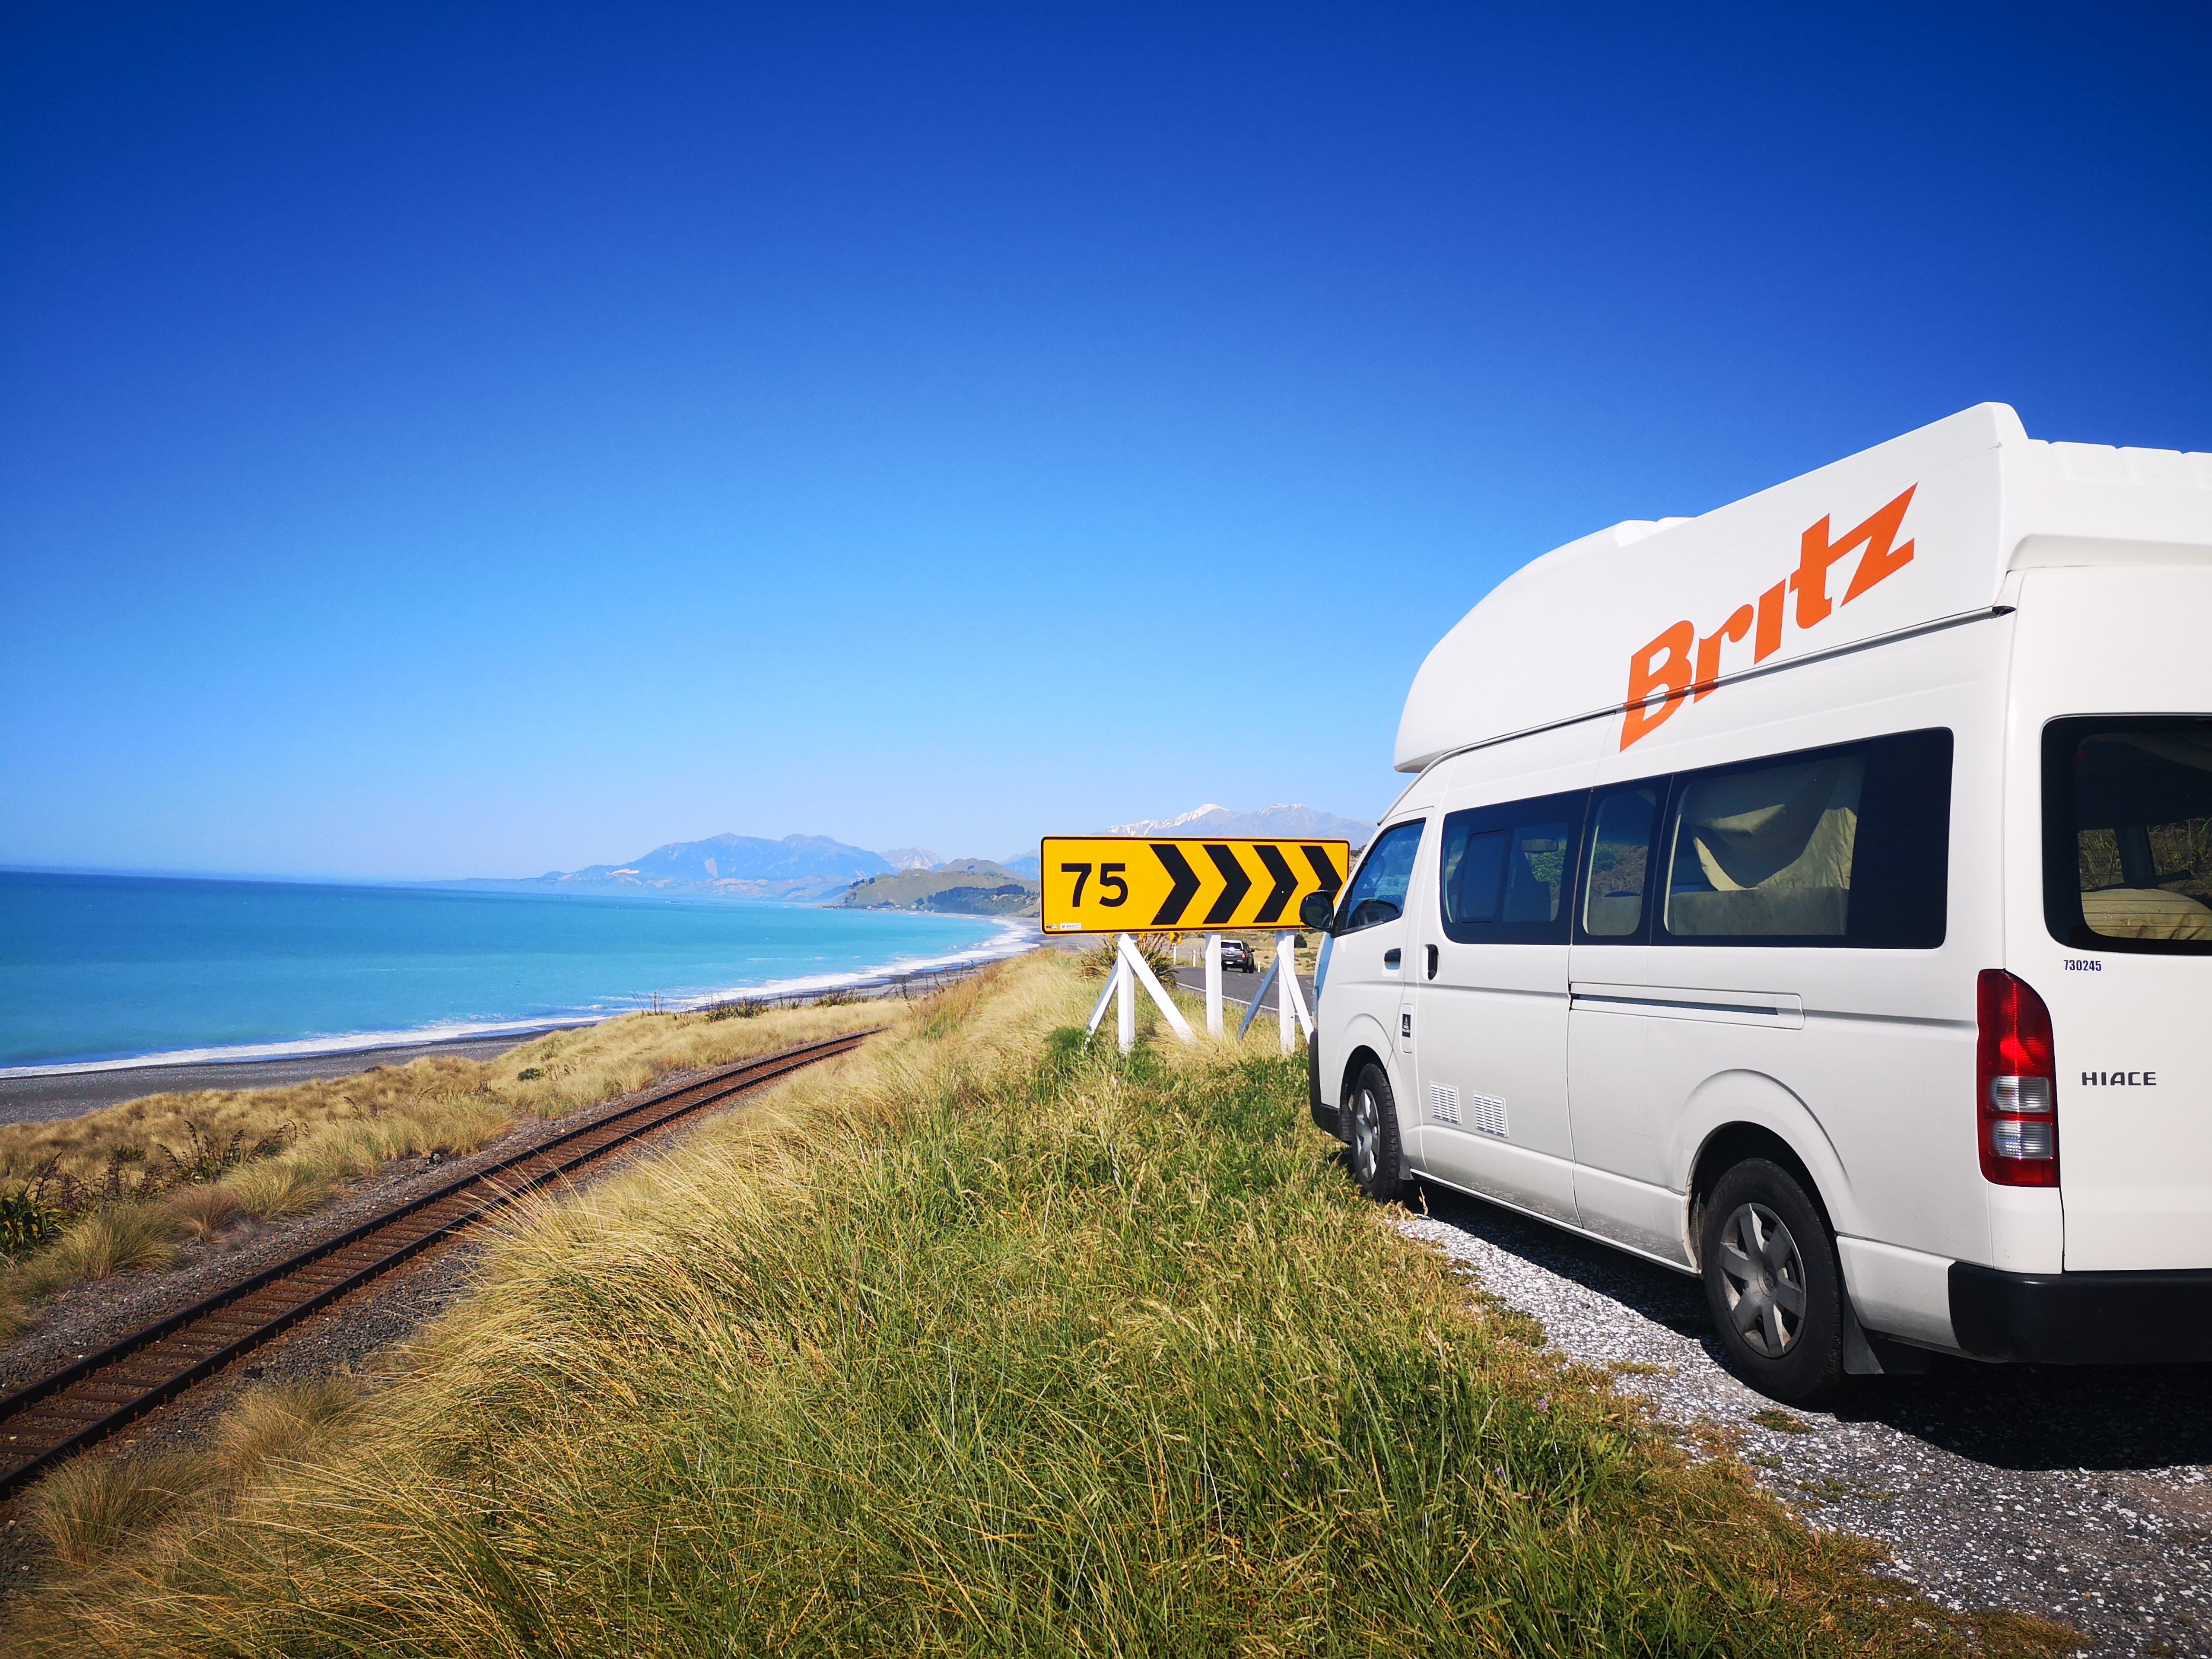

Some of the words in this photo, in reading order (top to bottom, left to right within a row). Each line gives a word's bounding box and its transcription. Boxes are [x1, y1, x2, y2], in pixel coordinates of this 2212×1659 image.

[1619, 481, 1919, 753] Britz
[1061, 863, 1128, 907] 75
[2063, 960, 2101, 971] 730245
[2082, 1072, 2157, 1086] HIACE
